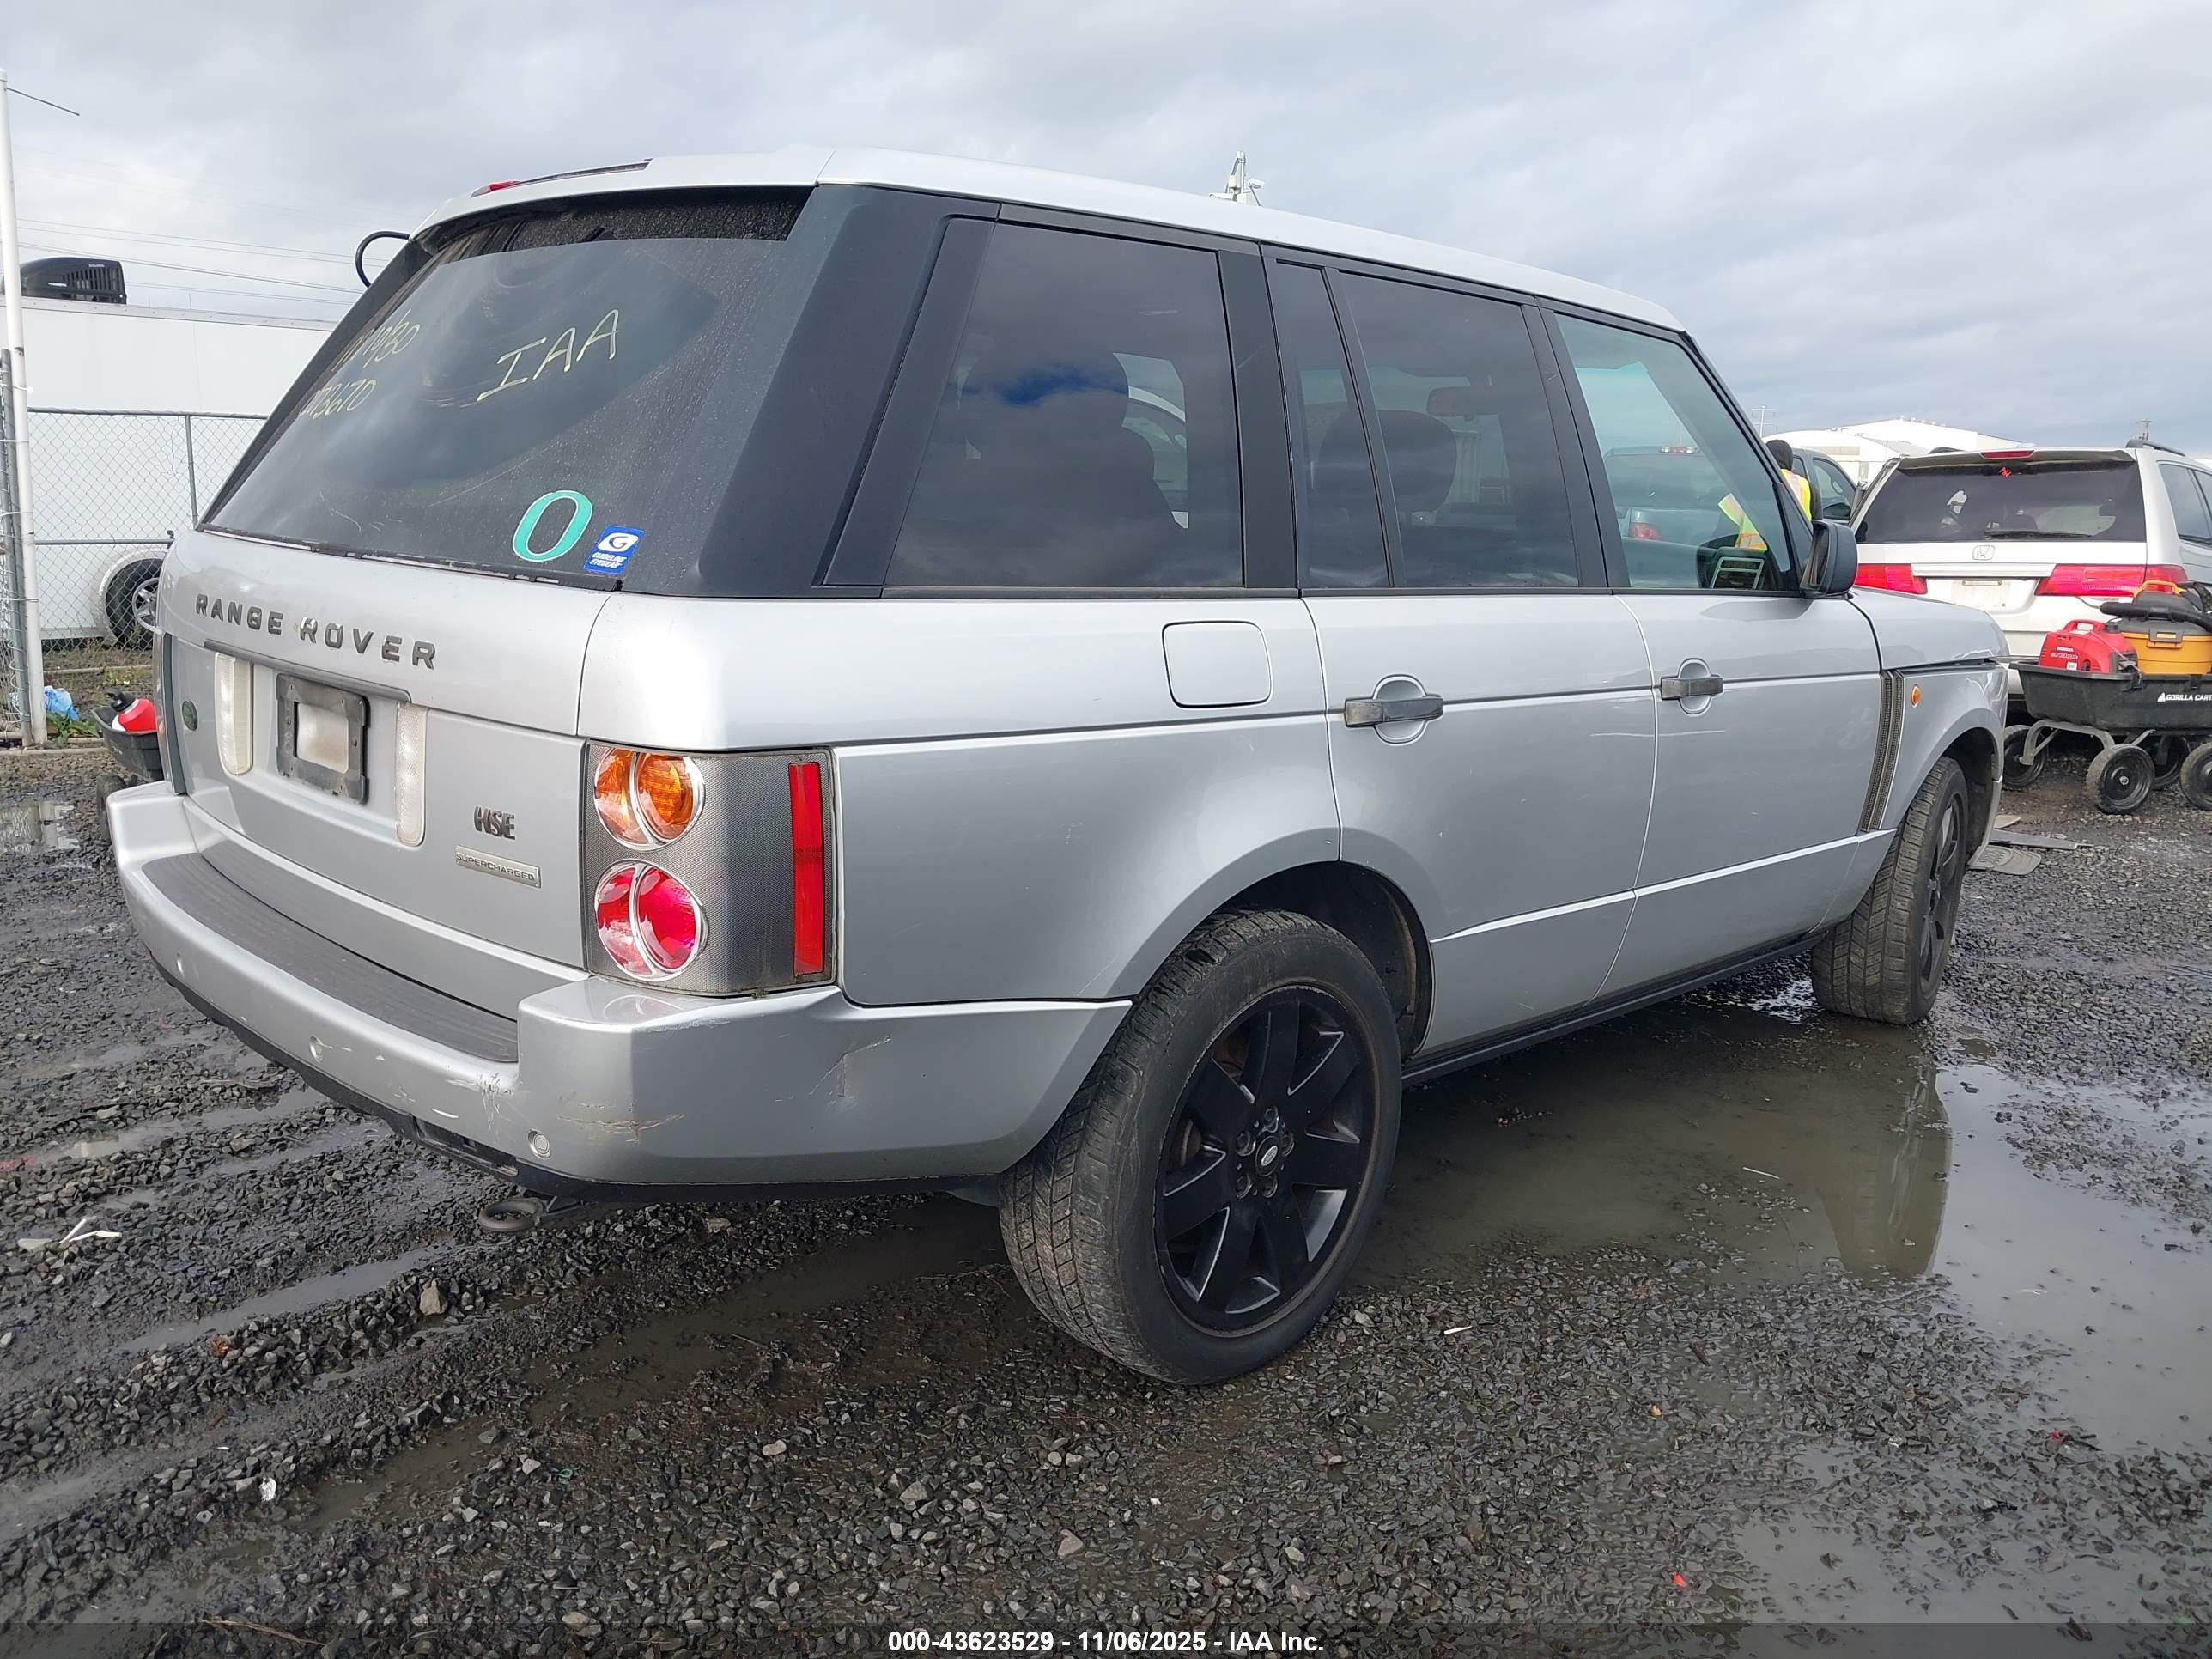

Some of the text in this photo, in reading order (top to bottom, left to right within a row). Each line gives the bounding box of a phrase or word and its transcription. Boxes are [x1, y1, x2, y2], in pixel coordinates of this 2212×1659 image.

[477, 309, 619, 401] IAA
[513, 489, 592, 562] O
[196, 593, 436, 670] RANGE ROVER
[474, 806, 516, 840] HSE
[456, 853, 536, 881] SUPERCHARGED
